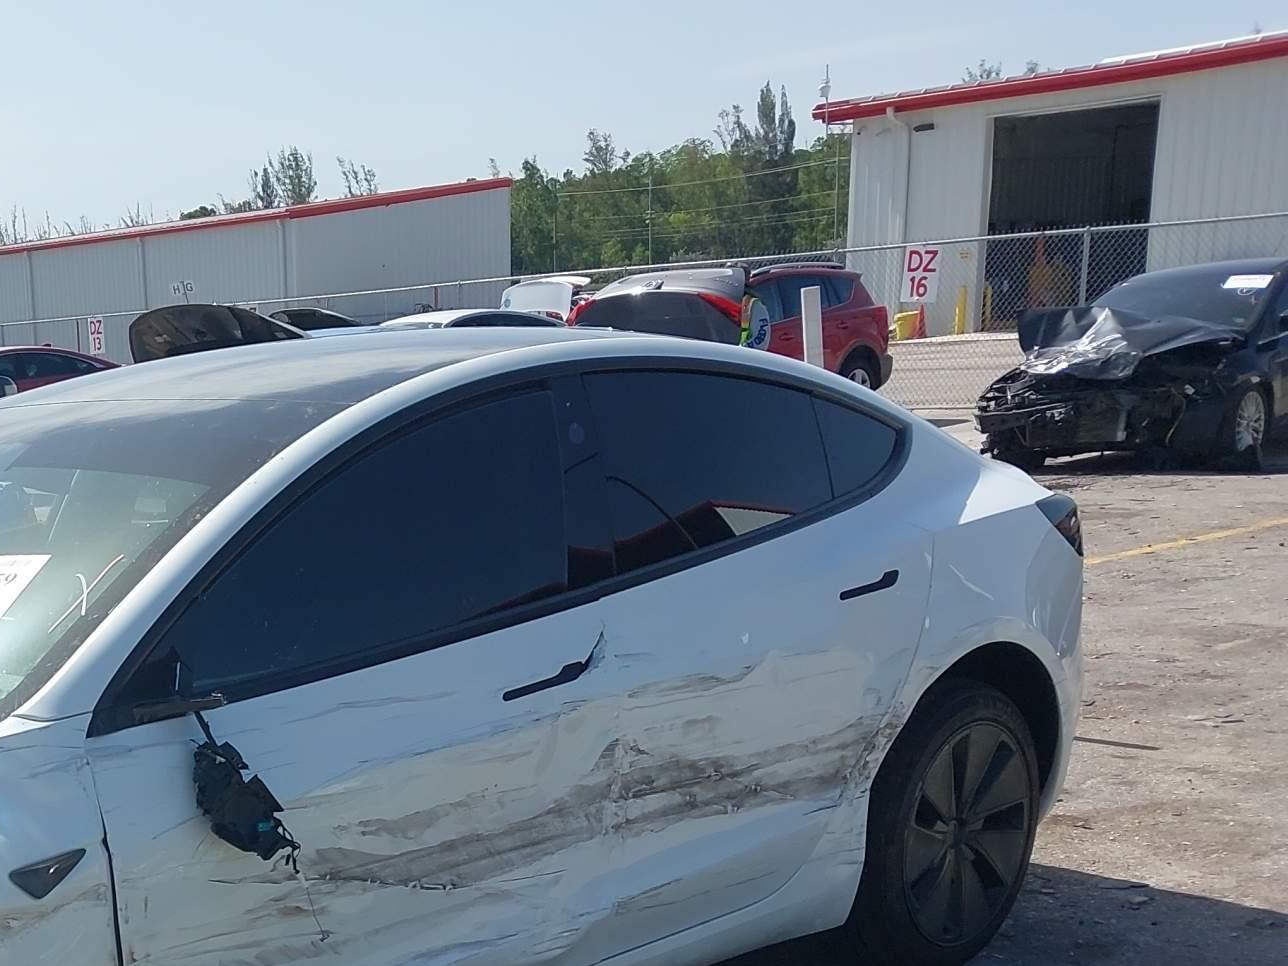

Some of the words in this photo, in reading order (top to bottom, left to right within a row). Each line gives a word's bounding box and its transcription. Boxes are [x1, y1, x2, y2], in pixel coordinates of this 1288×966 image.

[907, 249, 939, 273] DZ
[909, 275, 929, 298] 16
[89, 320, 103, 336] DZ
[92, 337, 102, 351] 13
